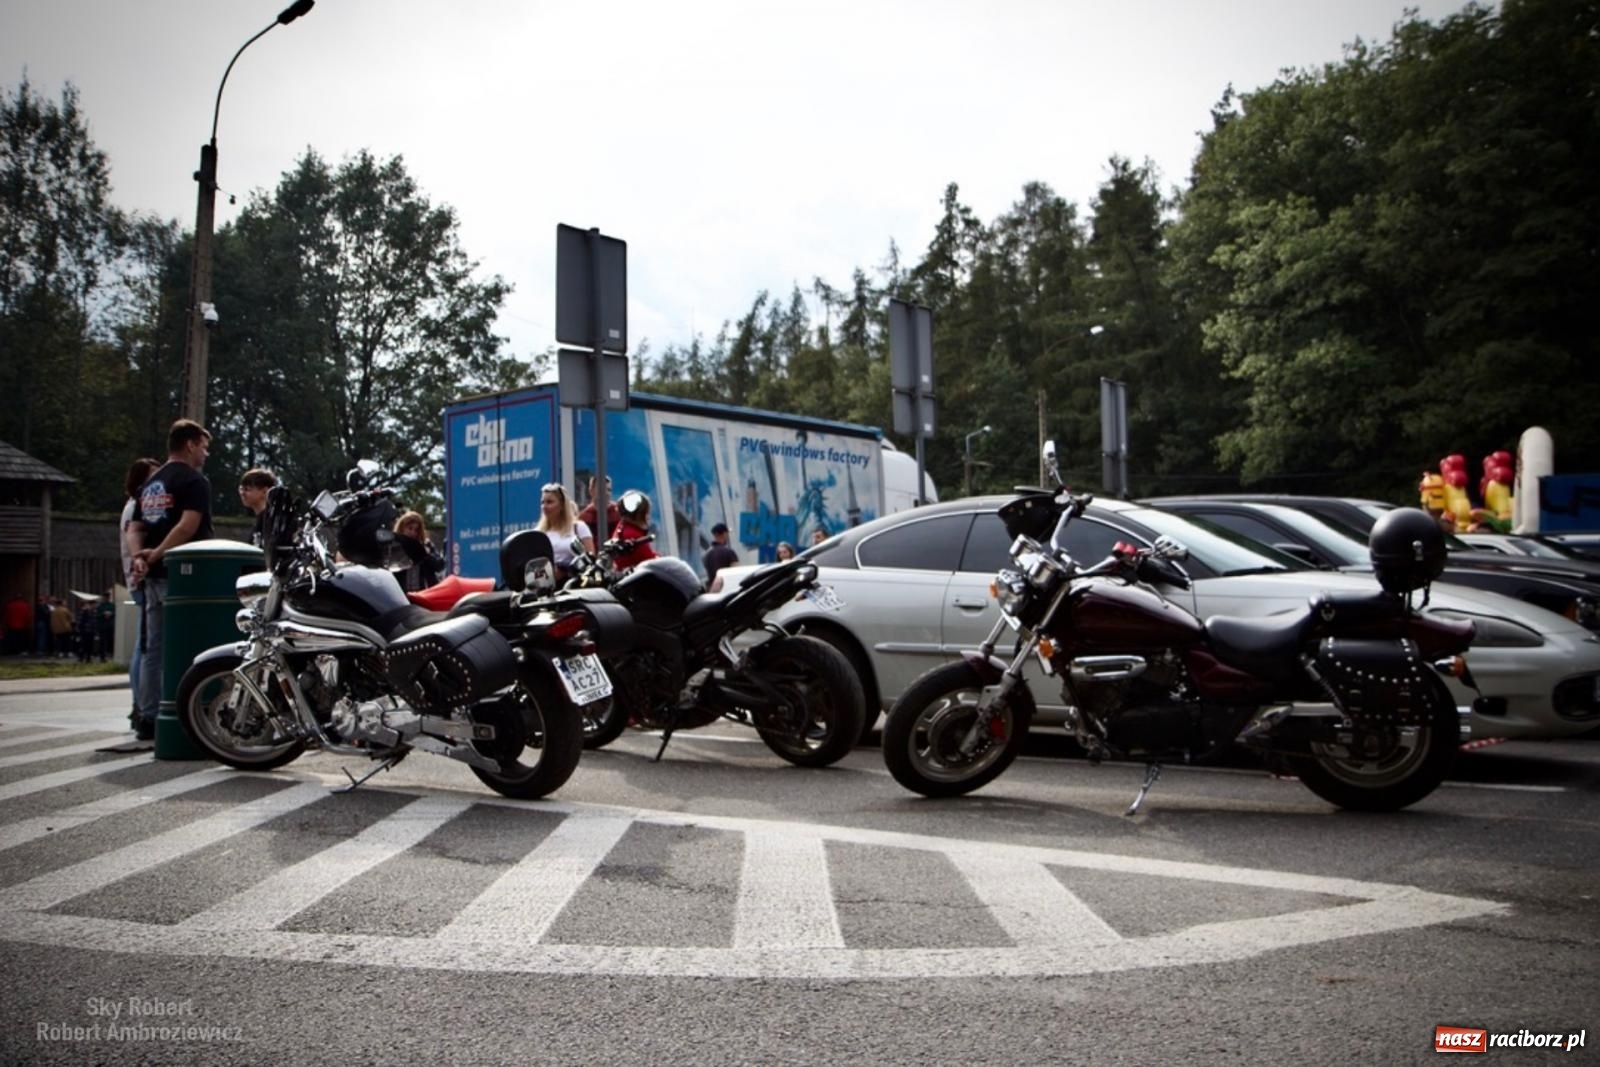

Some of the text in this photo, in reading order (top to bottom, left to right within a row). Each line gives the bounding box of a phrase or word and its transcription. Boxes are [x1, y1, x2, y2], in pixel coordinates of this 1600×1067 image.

[739, 437, 870, 469] PVC windows factory
[477, 472, 511, 485] windows
[512, 468, 541, 480] factory
[568, 656, 592, 675] SRC
[571, 671, 600, 692] AC27
